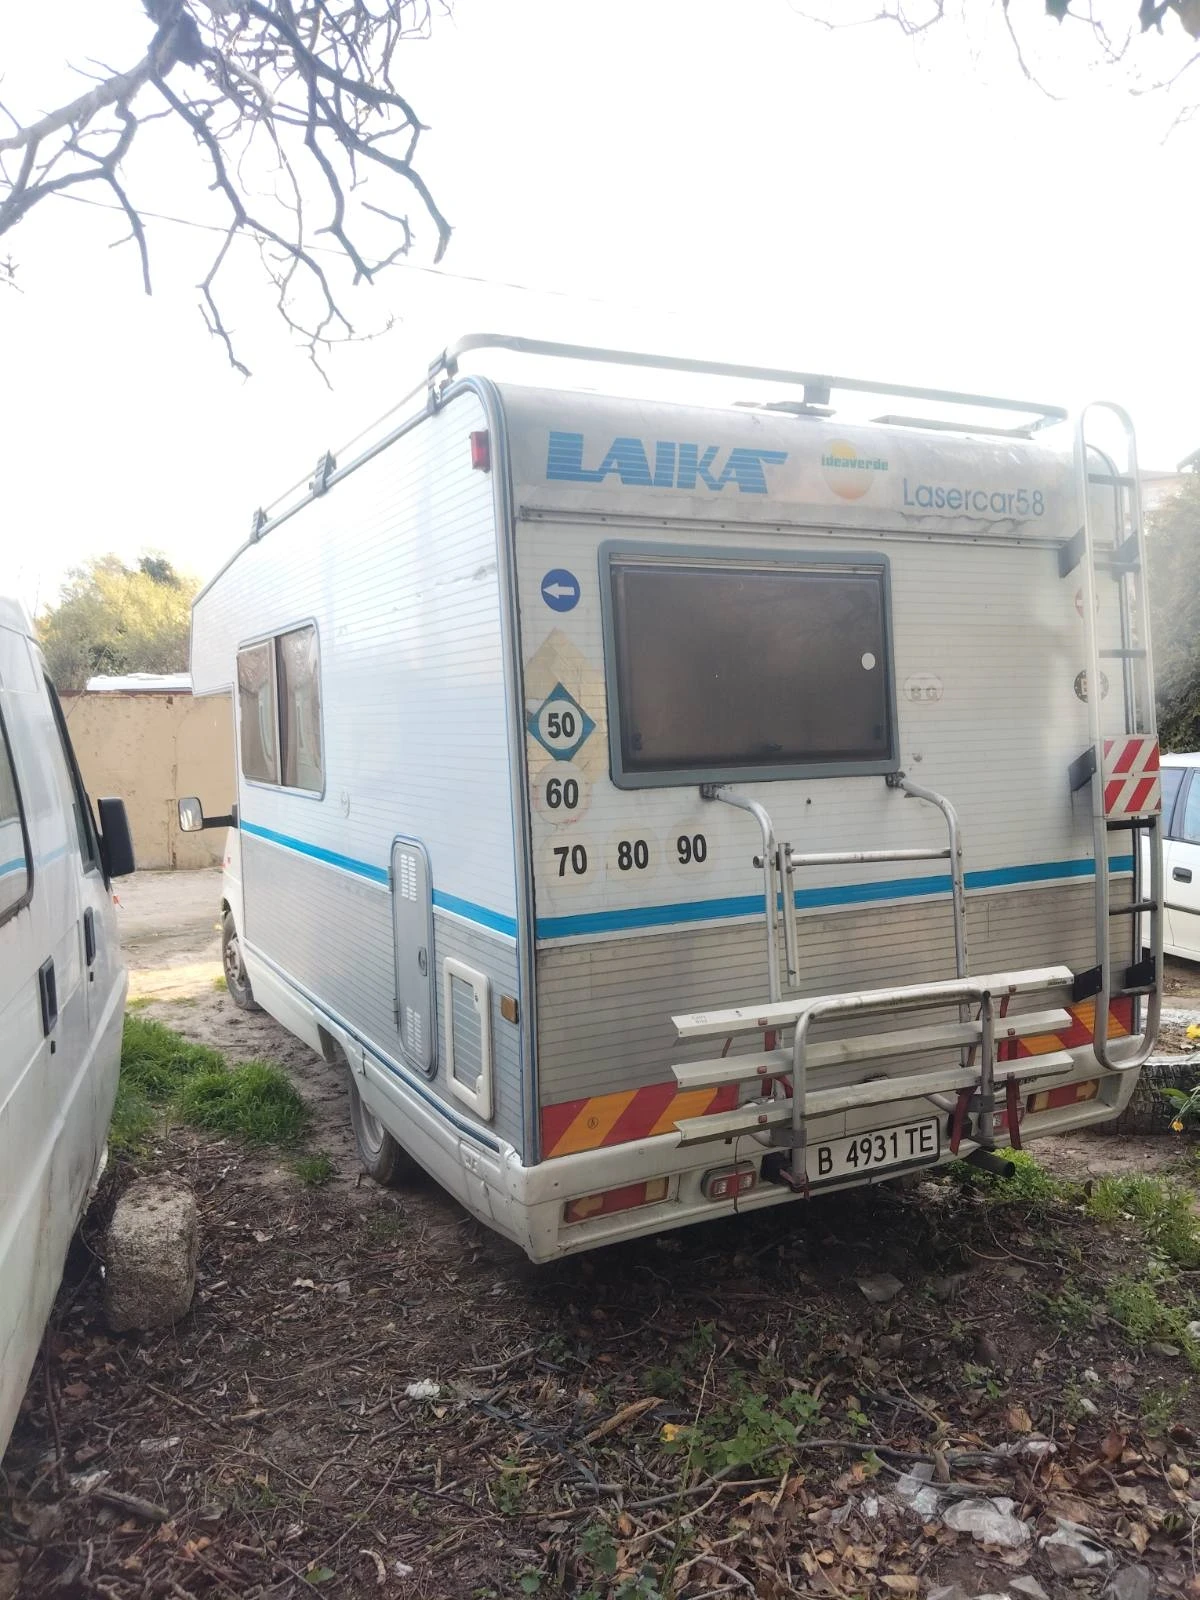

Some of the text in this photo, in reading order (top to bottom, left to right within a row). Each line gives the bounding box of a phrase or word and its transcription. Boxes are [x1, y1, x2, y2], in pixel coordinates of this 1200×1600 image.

[821, 453, 889, 471] ideaverde
[547, 711, 576, 739] 50
[546, 778, 579, 809] 60
[553, 844, 588, 877] 70
[617, 839, 649, 871] 80
[677, 834, 708, 865] 90
[818, 1124, 934, 1176] B 4931 TE
